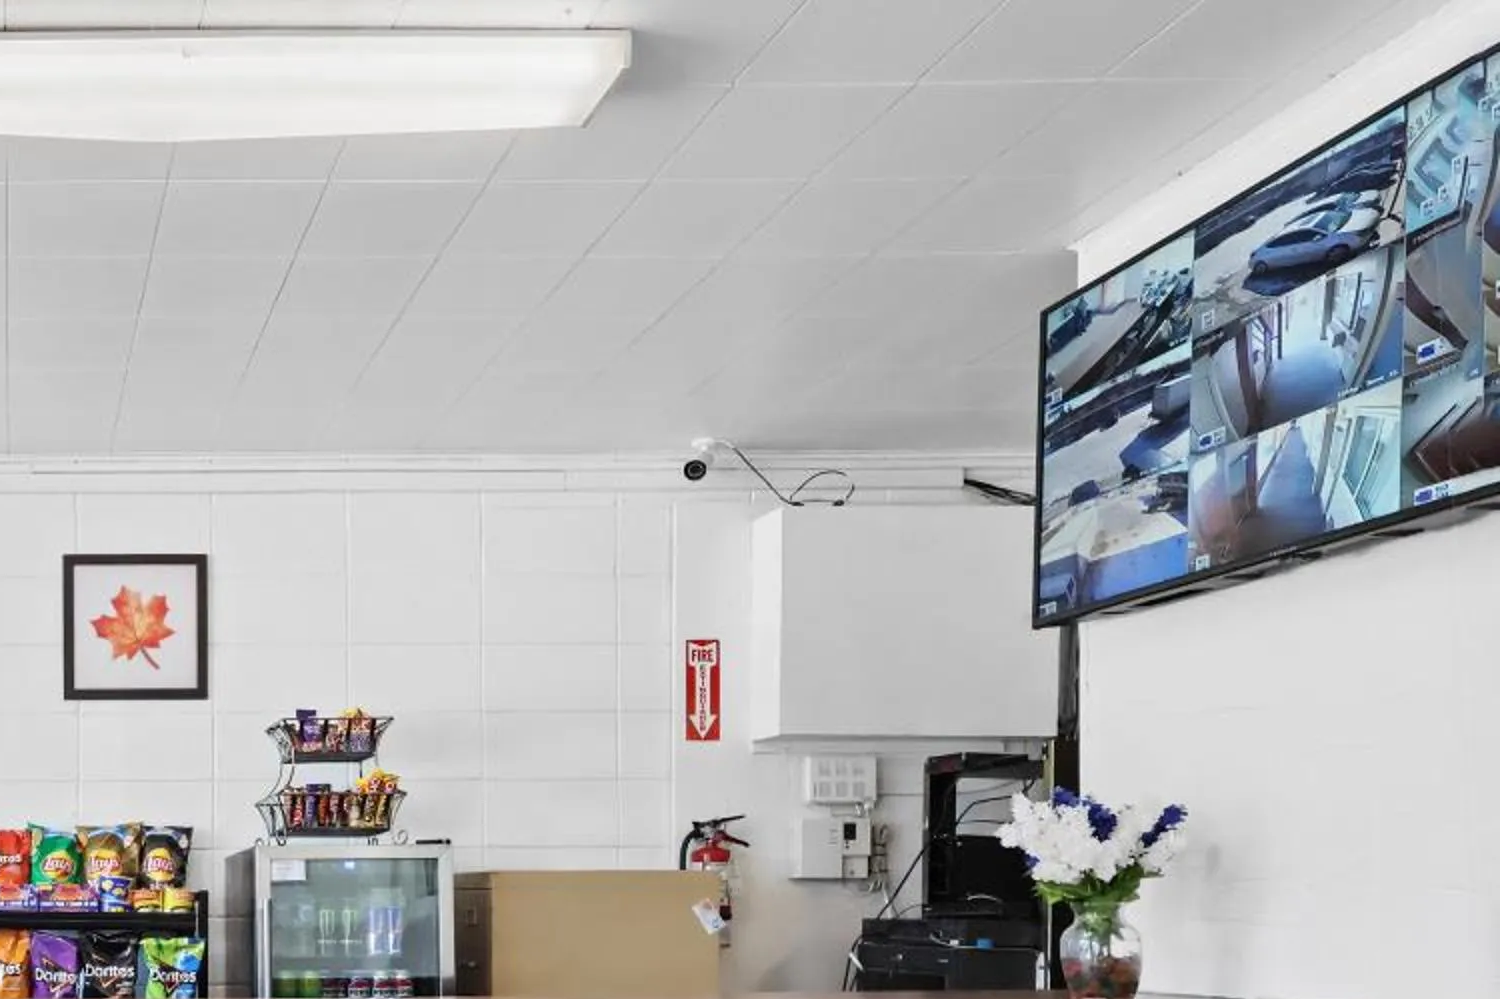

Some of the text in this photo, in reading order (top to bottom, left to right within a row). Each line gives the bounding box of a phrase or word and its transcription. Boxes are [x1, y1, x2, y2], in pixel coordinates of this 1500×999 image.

[691, 649, 714, 662] FIRE
[35, 967, 76, 985] Dorito
[85, 963, 135, 978] Doritos
[150, 967, 197, 983] Doritos
